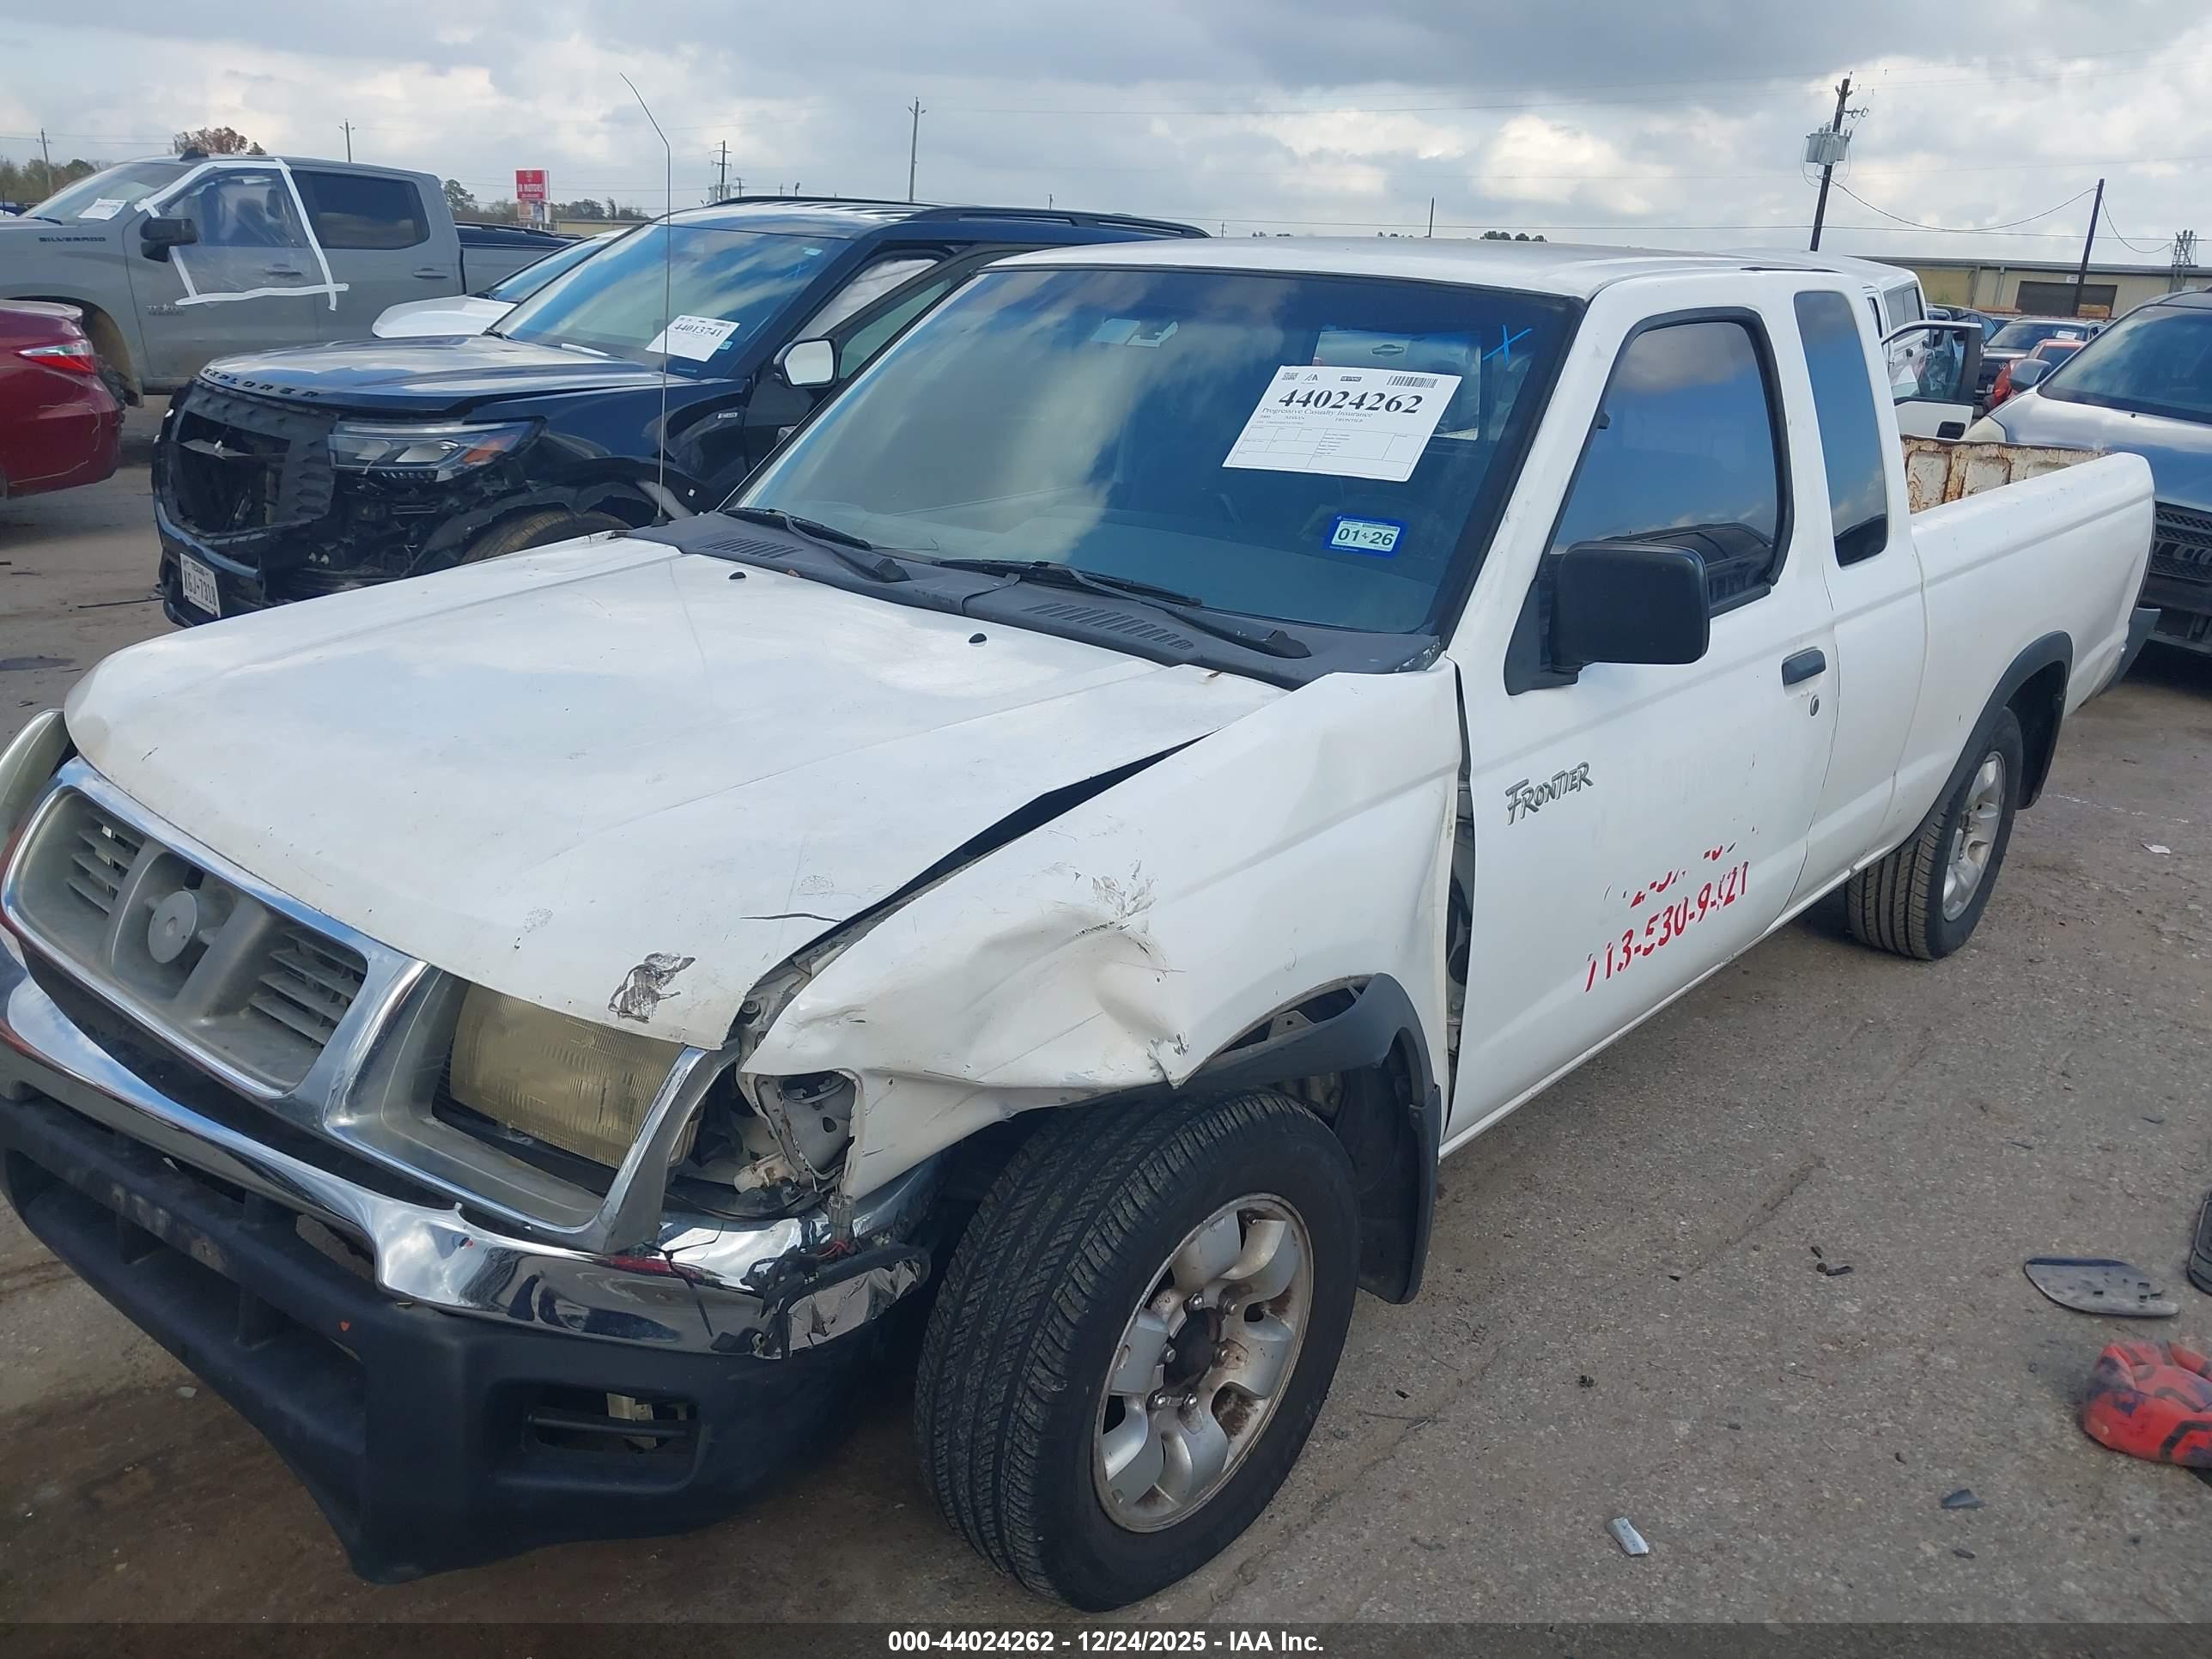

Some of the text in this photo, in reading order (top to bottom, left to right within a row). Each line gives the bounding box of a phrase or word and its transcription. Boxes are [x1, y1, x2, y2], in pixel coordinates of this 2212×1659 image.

[204, 368, 319, 398] EXPLORER
[1278, 389, 1424, 414] 44024262
[1337, 410, 1374, 418] Insurance
